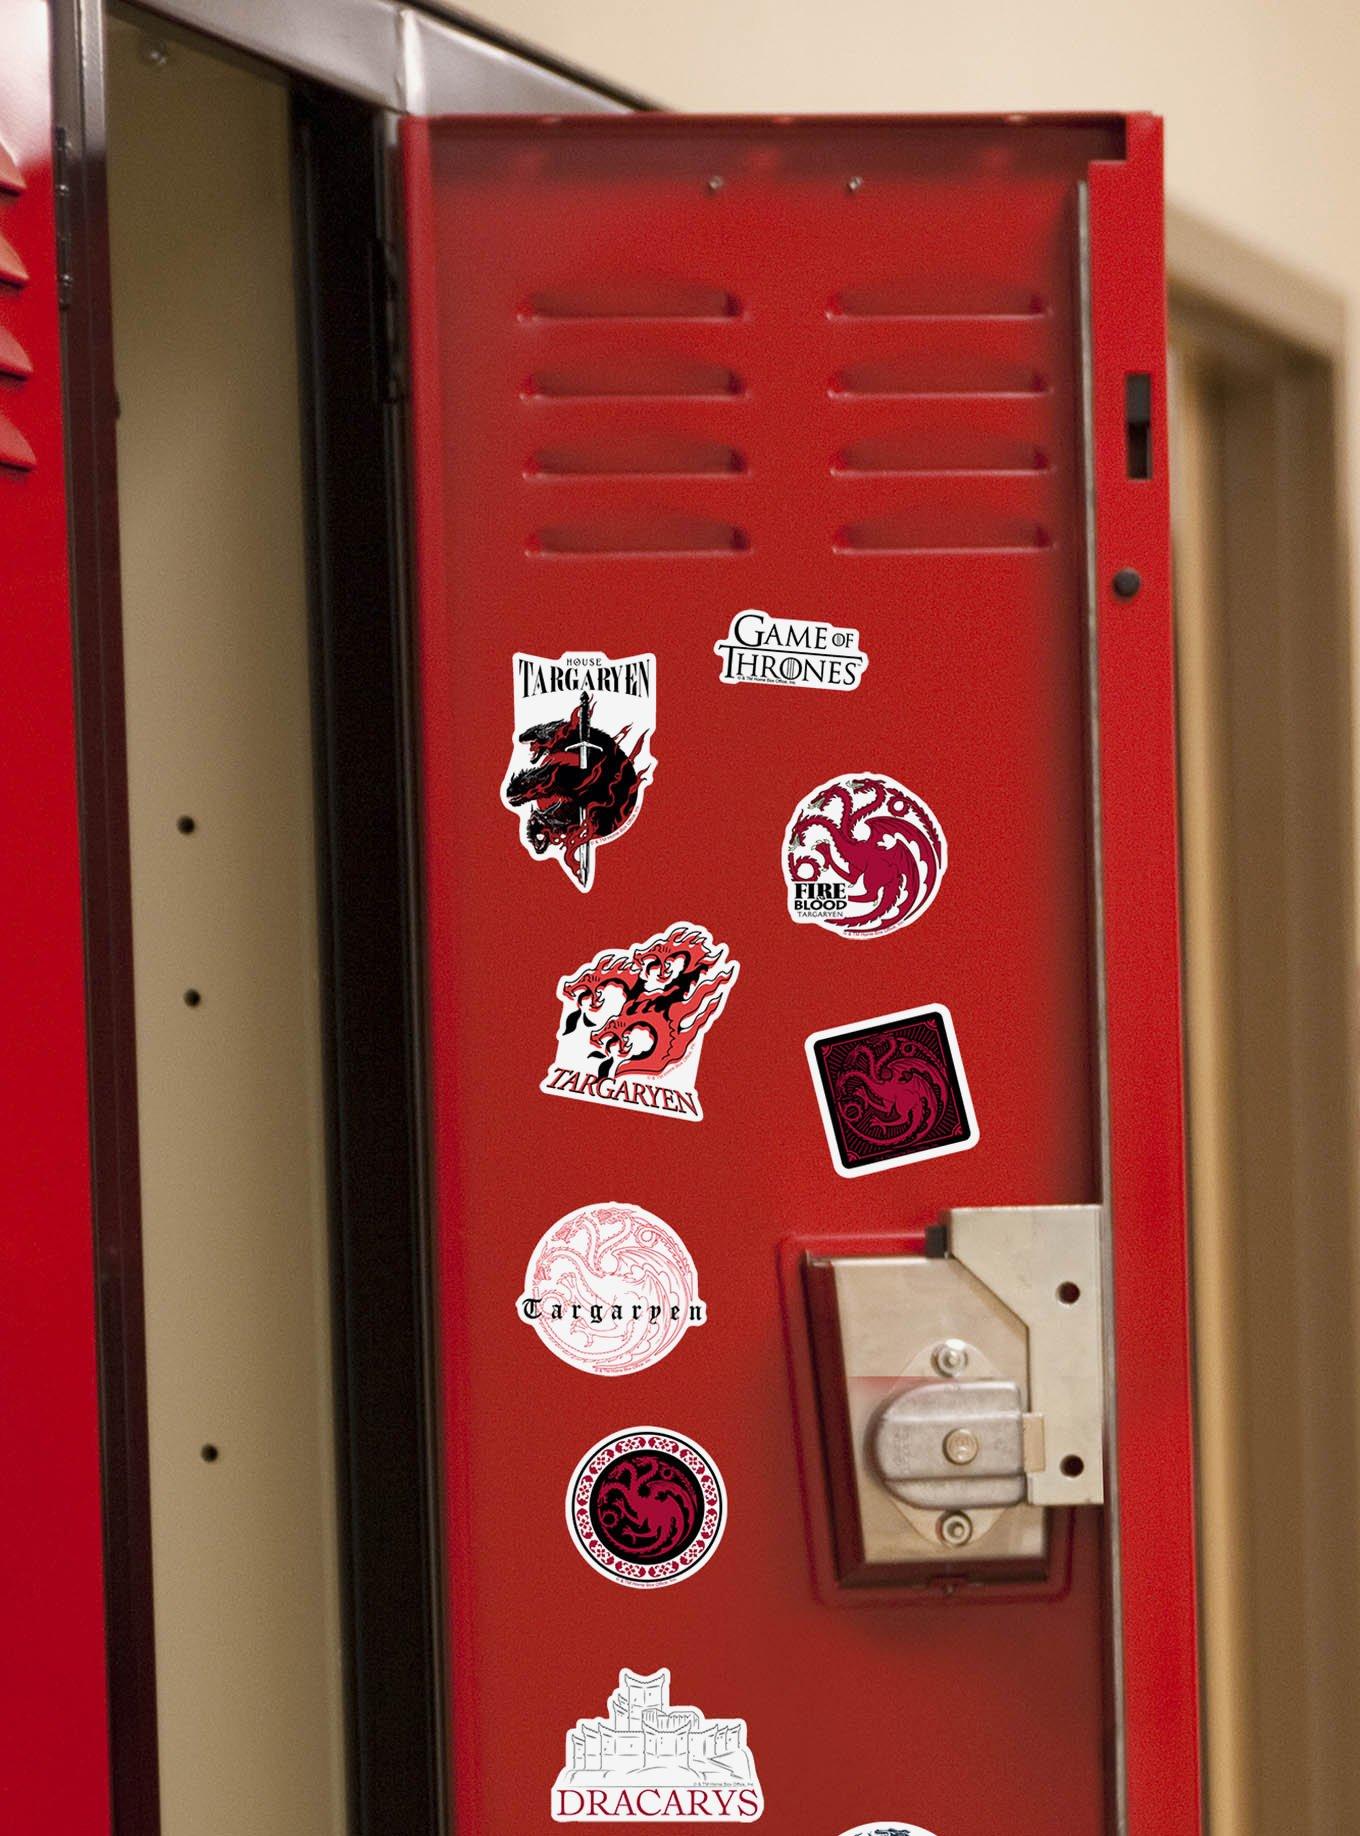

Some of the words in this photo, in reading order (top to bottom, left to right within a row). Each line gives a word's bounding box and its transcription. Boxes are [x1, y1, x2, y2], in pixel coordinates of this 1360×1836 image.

[734, 614, 827, 650] GAME
[831, 633, 854, 648] OF
[566, 658, 602, 666] HOUSE
[718, 645, 863, 686] THRONES
[519, 659, 650, 698] TARGARYEN
[795, 883, 846, 899] FIRE
[795, 900, 848, 910] BLOOD
[546, 1068, 698, 1116] TARGARYEN
[522, 1298, 702, 1324] Targaryen
[557, 1788, 759, 1816] DRACARYS
